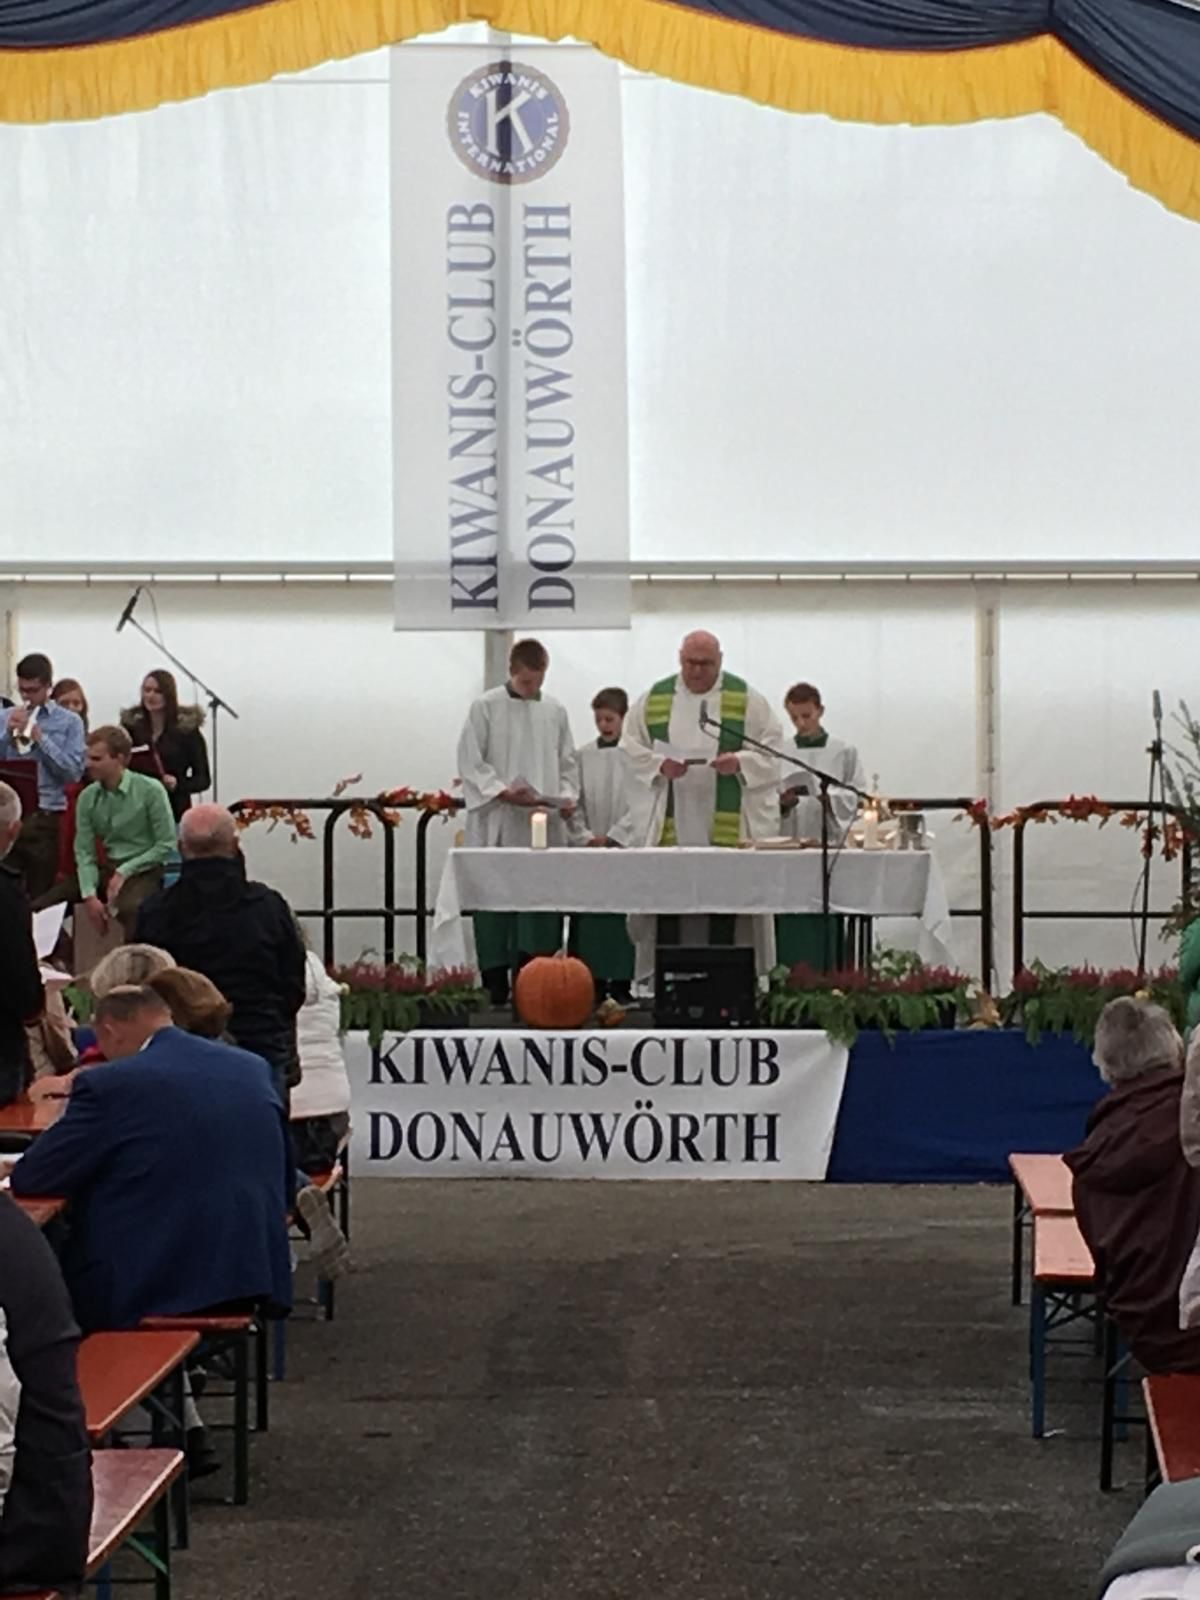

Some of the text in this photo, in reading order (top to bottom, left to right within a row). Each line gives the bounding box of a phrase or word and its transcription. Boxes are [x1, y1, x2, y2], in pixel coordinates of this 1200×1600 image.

[469, 73, 549, 100] KIWANIS
[457, 111, 559, 174] INTERNATIONAL
[484, 89, 534, 157] K
[447, 203, 499, 612] KIWANIS-CLUB
[511, 203, 576, 612] DONAUWÖRTH
[368, 1036, 781, 1087] KIWANIS-CLUB
[367, 1100, 781, 1163] DONAUWÖRTH
